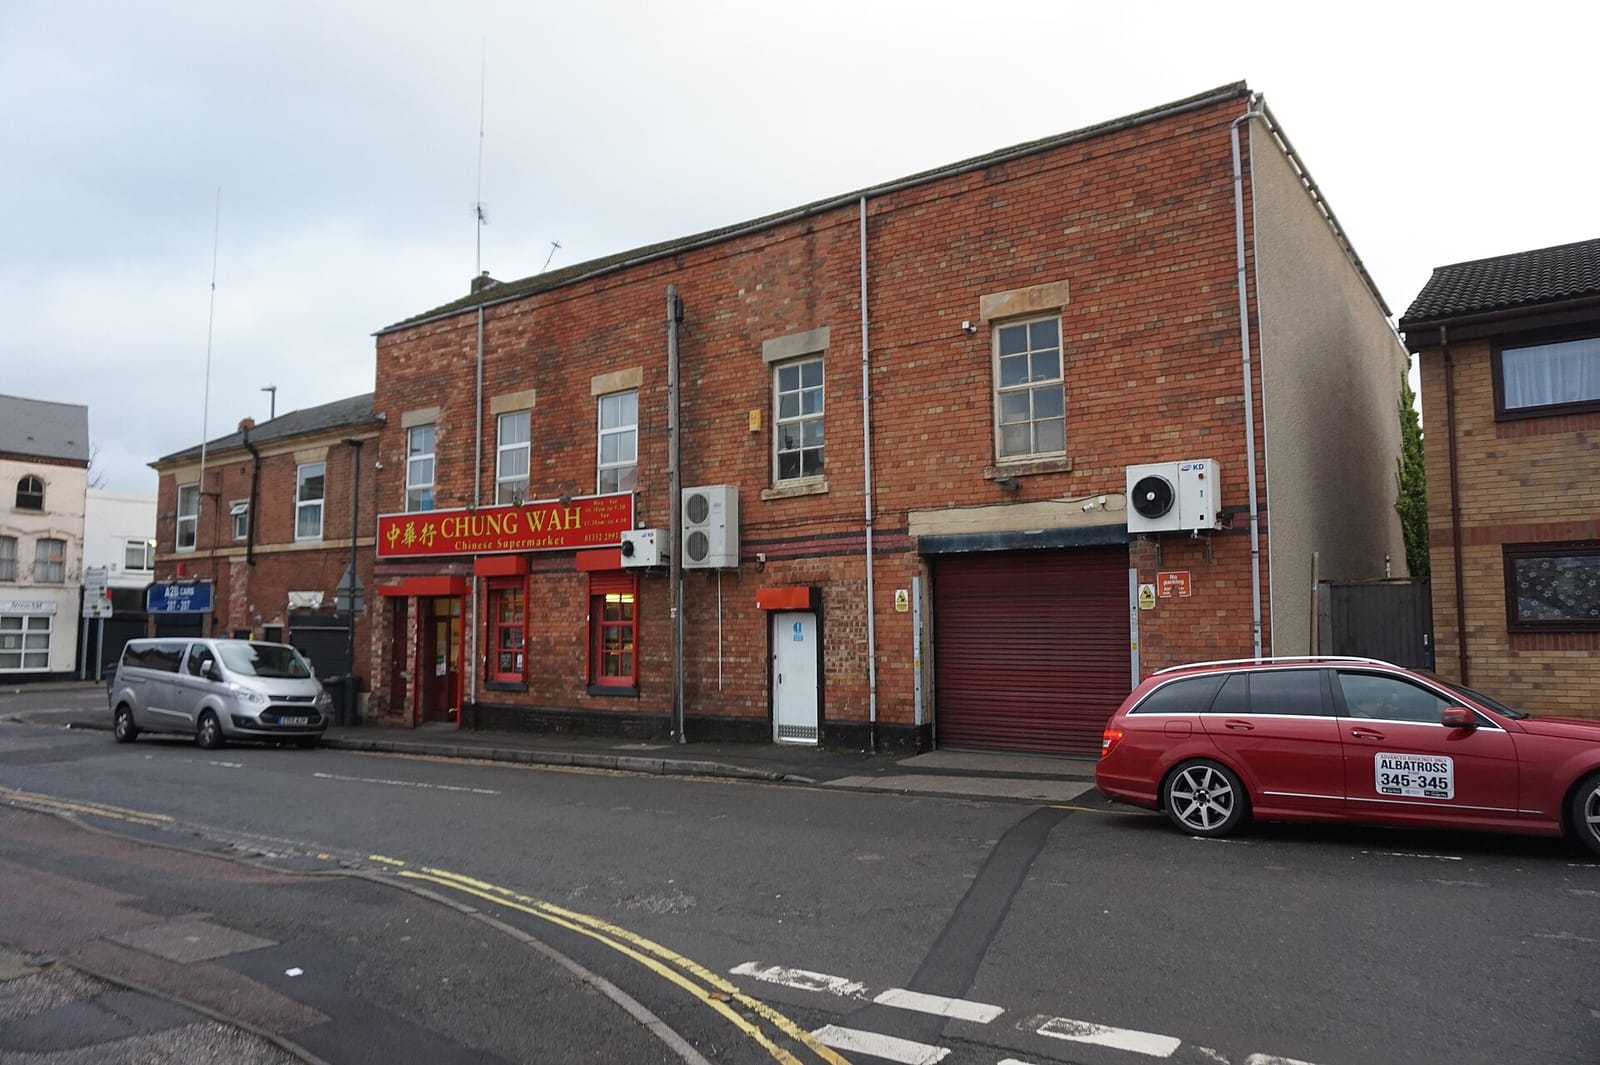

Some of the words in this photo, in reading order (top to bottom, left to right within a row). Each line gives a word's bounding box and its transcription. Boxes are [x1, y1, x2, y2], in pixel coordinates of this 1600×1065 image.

[1192, 463, 1205, 471] KD
[441, 512, 518, 539] CHUNG
[526, 506, 582, 533] WAH
[386, 521, 437, 549] 中華行
[455, 540, 493, 551] Chinese
[497, 535, 565, 549] Supermarket
[1381, 760, 1448, 773] ALBATROSS
[1381, 773, 1448, 789] 345-345
